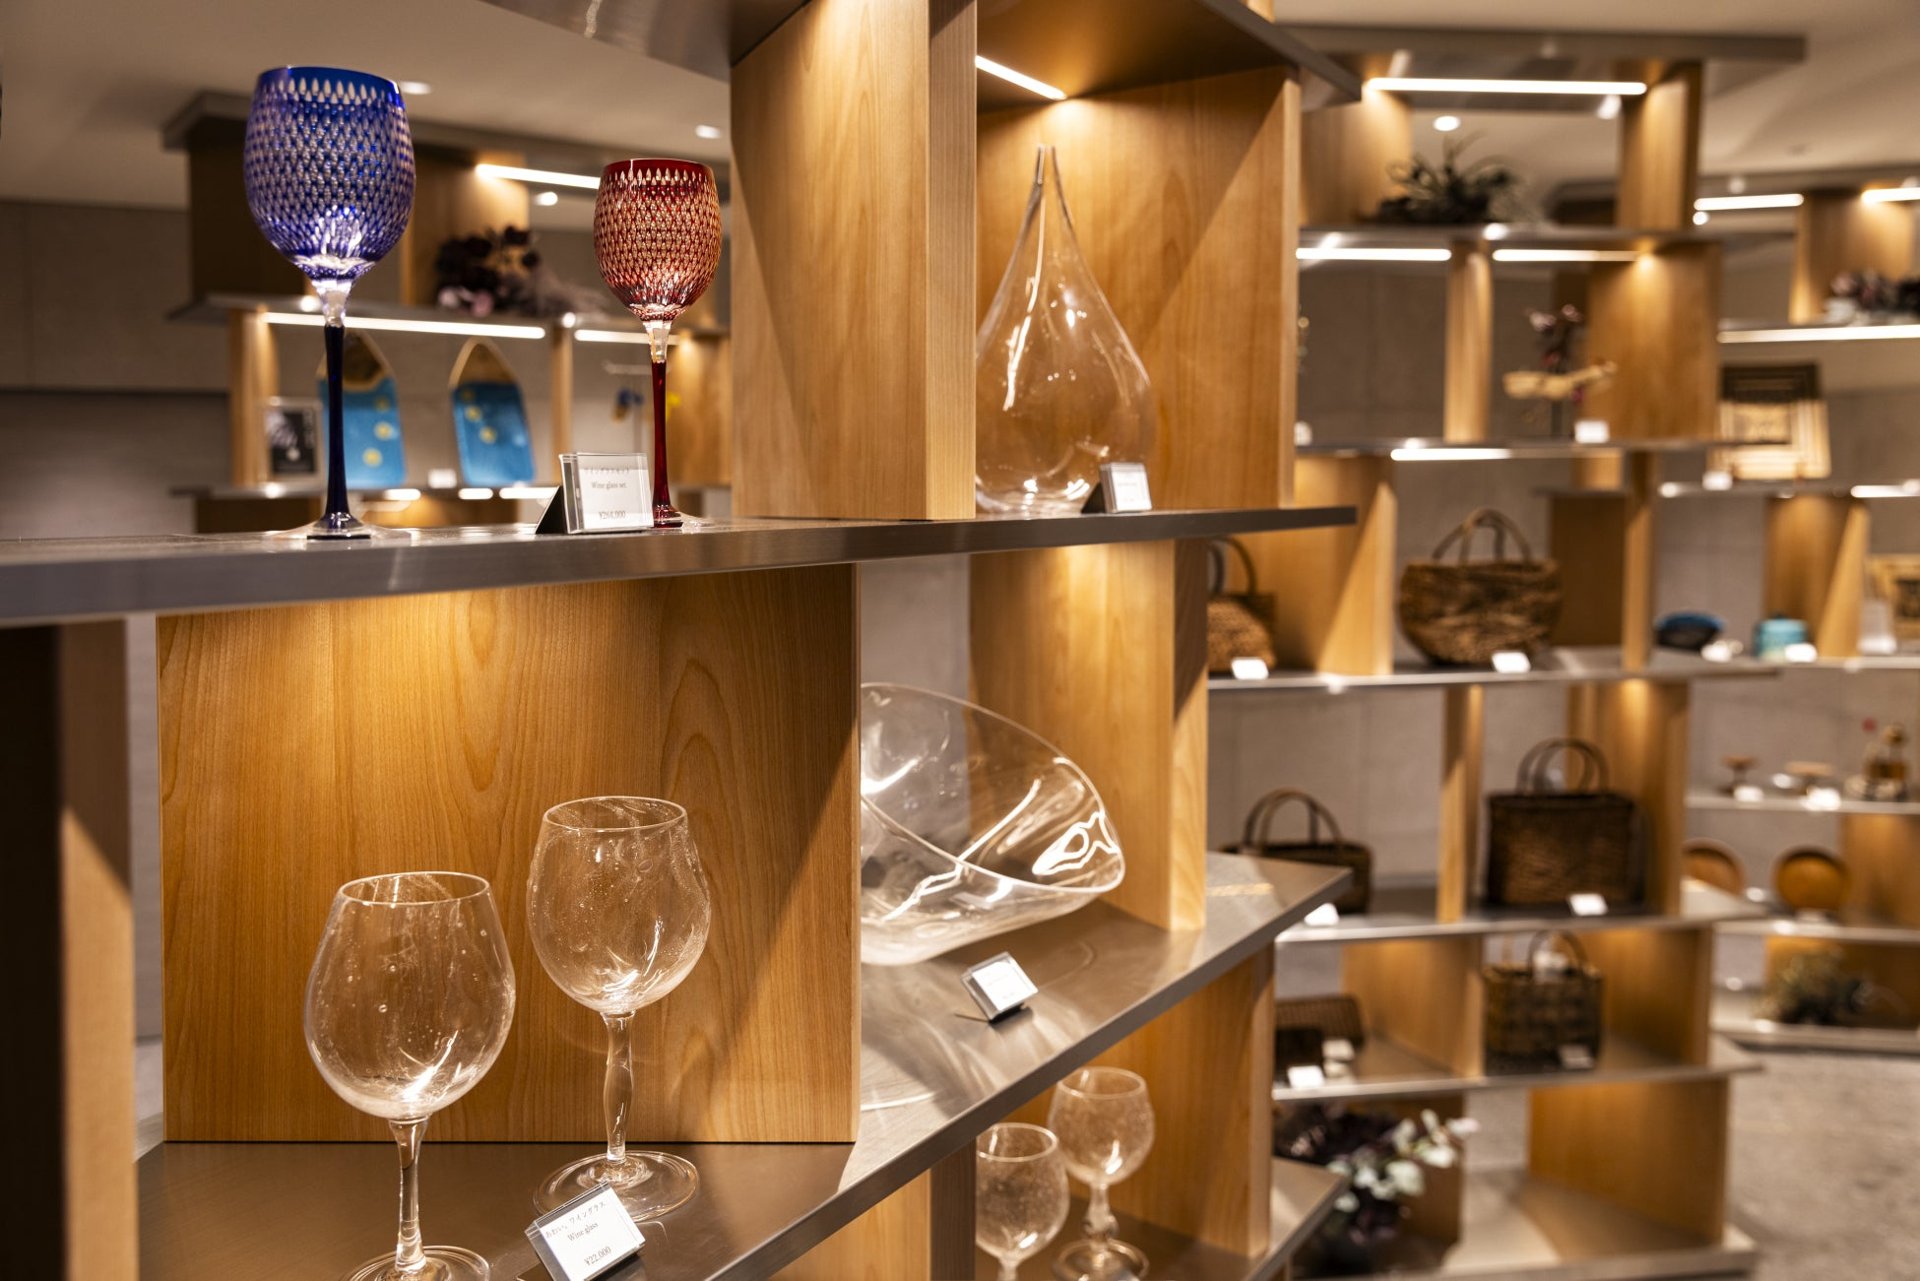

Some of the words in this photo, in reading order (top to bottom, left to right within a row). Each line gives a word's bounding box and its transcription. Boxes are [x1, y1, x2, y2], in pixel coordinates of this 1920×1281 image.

[591, 481, 605, 489] Wine
[606, 481, 618, 490] glass
[567, 1231, 584, 1241] Wine
[584, 1222, 599, 1235] glass
